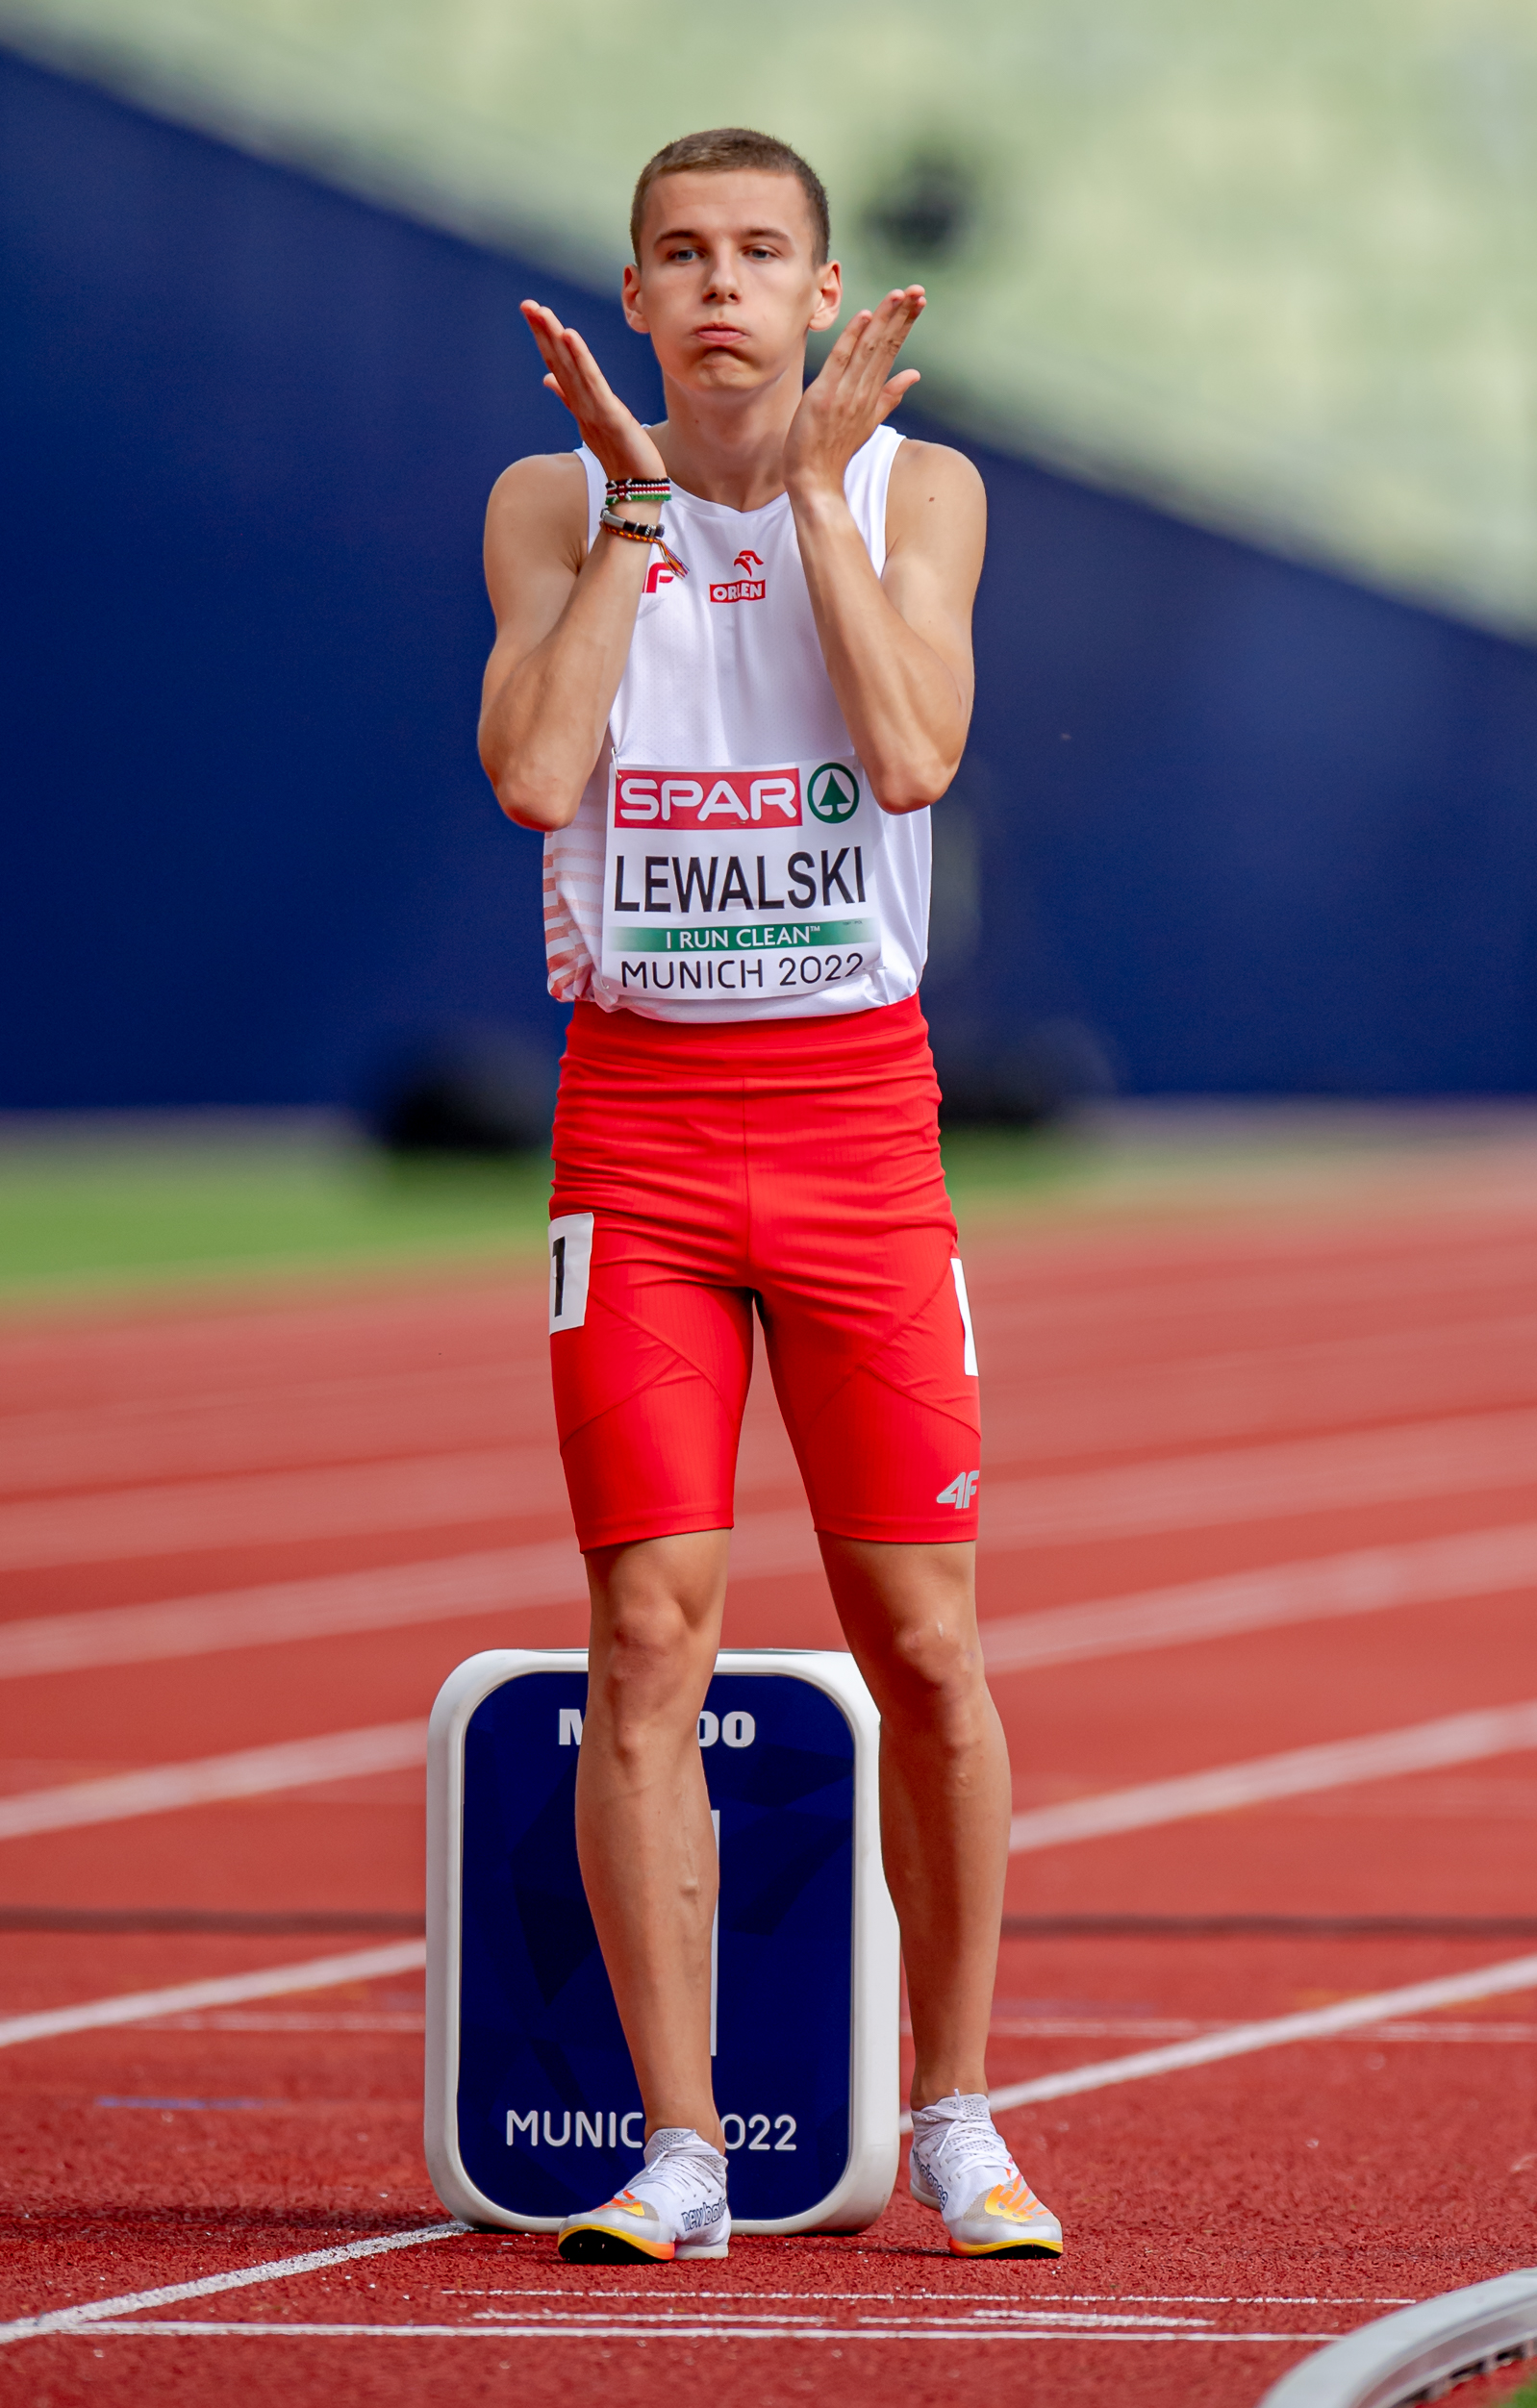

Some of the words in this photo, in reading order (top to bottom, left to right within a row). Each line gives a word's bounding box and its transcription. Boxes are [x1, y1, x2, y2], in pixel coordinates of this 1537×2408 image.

[642, 562, 675, 593] F
[713, 582, 763, 602] ORLEN
[619, 777, 797, 822] SPAR
[614, 845, 867, 914] LEWALSKI
[666, 931, 672, 949] I
[679, 929, 729, 949] RUN
[620, 959, 764, 990] MUNICH
[778, 952, 864, 987] 2022
[552, 1236, 566, 1317] 1
[936, 1470, 980, 1510] 4F
[506, 2110, 643, 2148] MUNIC
[720, 2114, 797, 2150] 022
[681, 2207, 703, 2232] new
